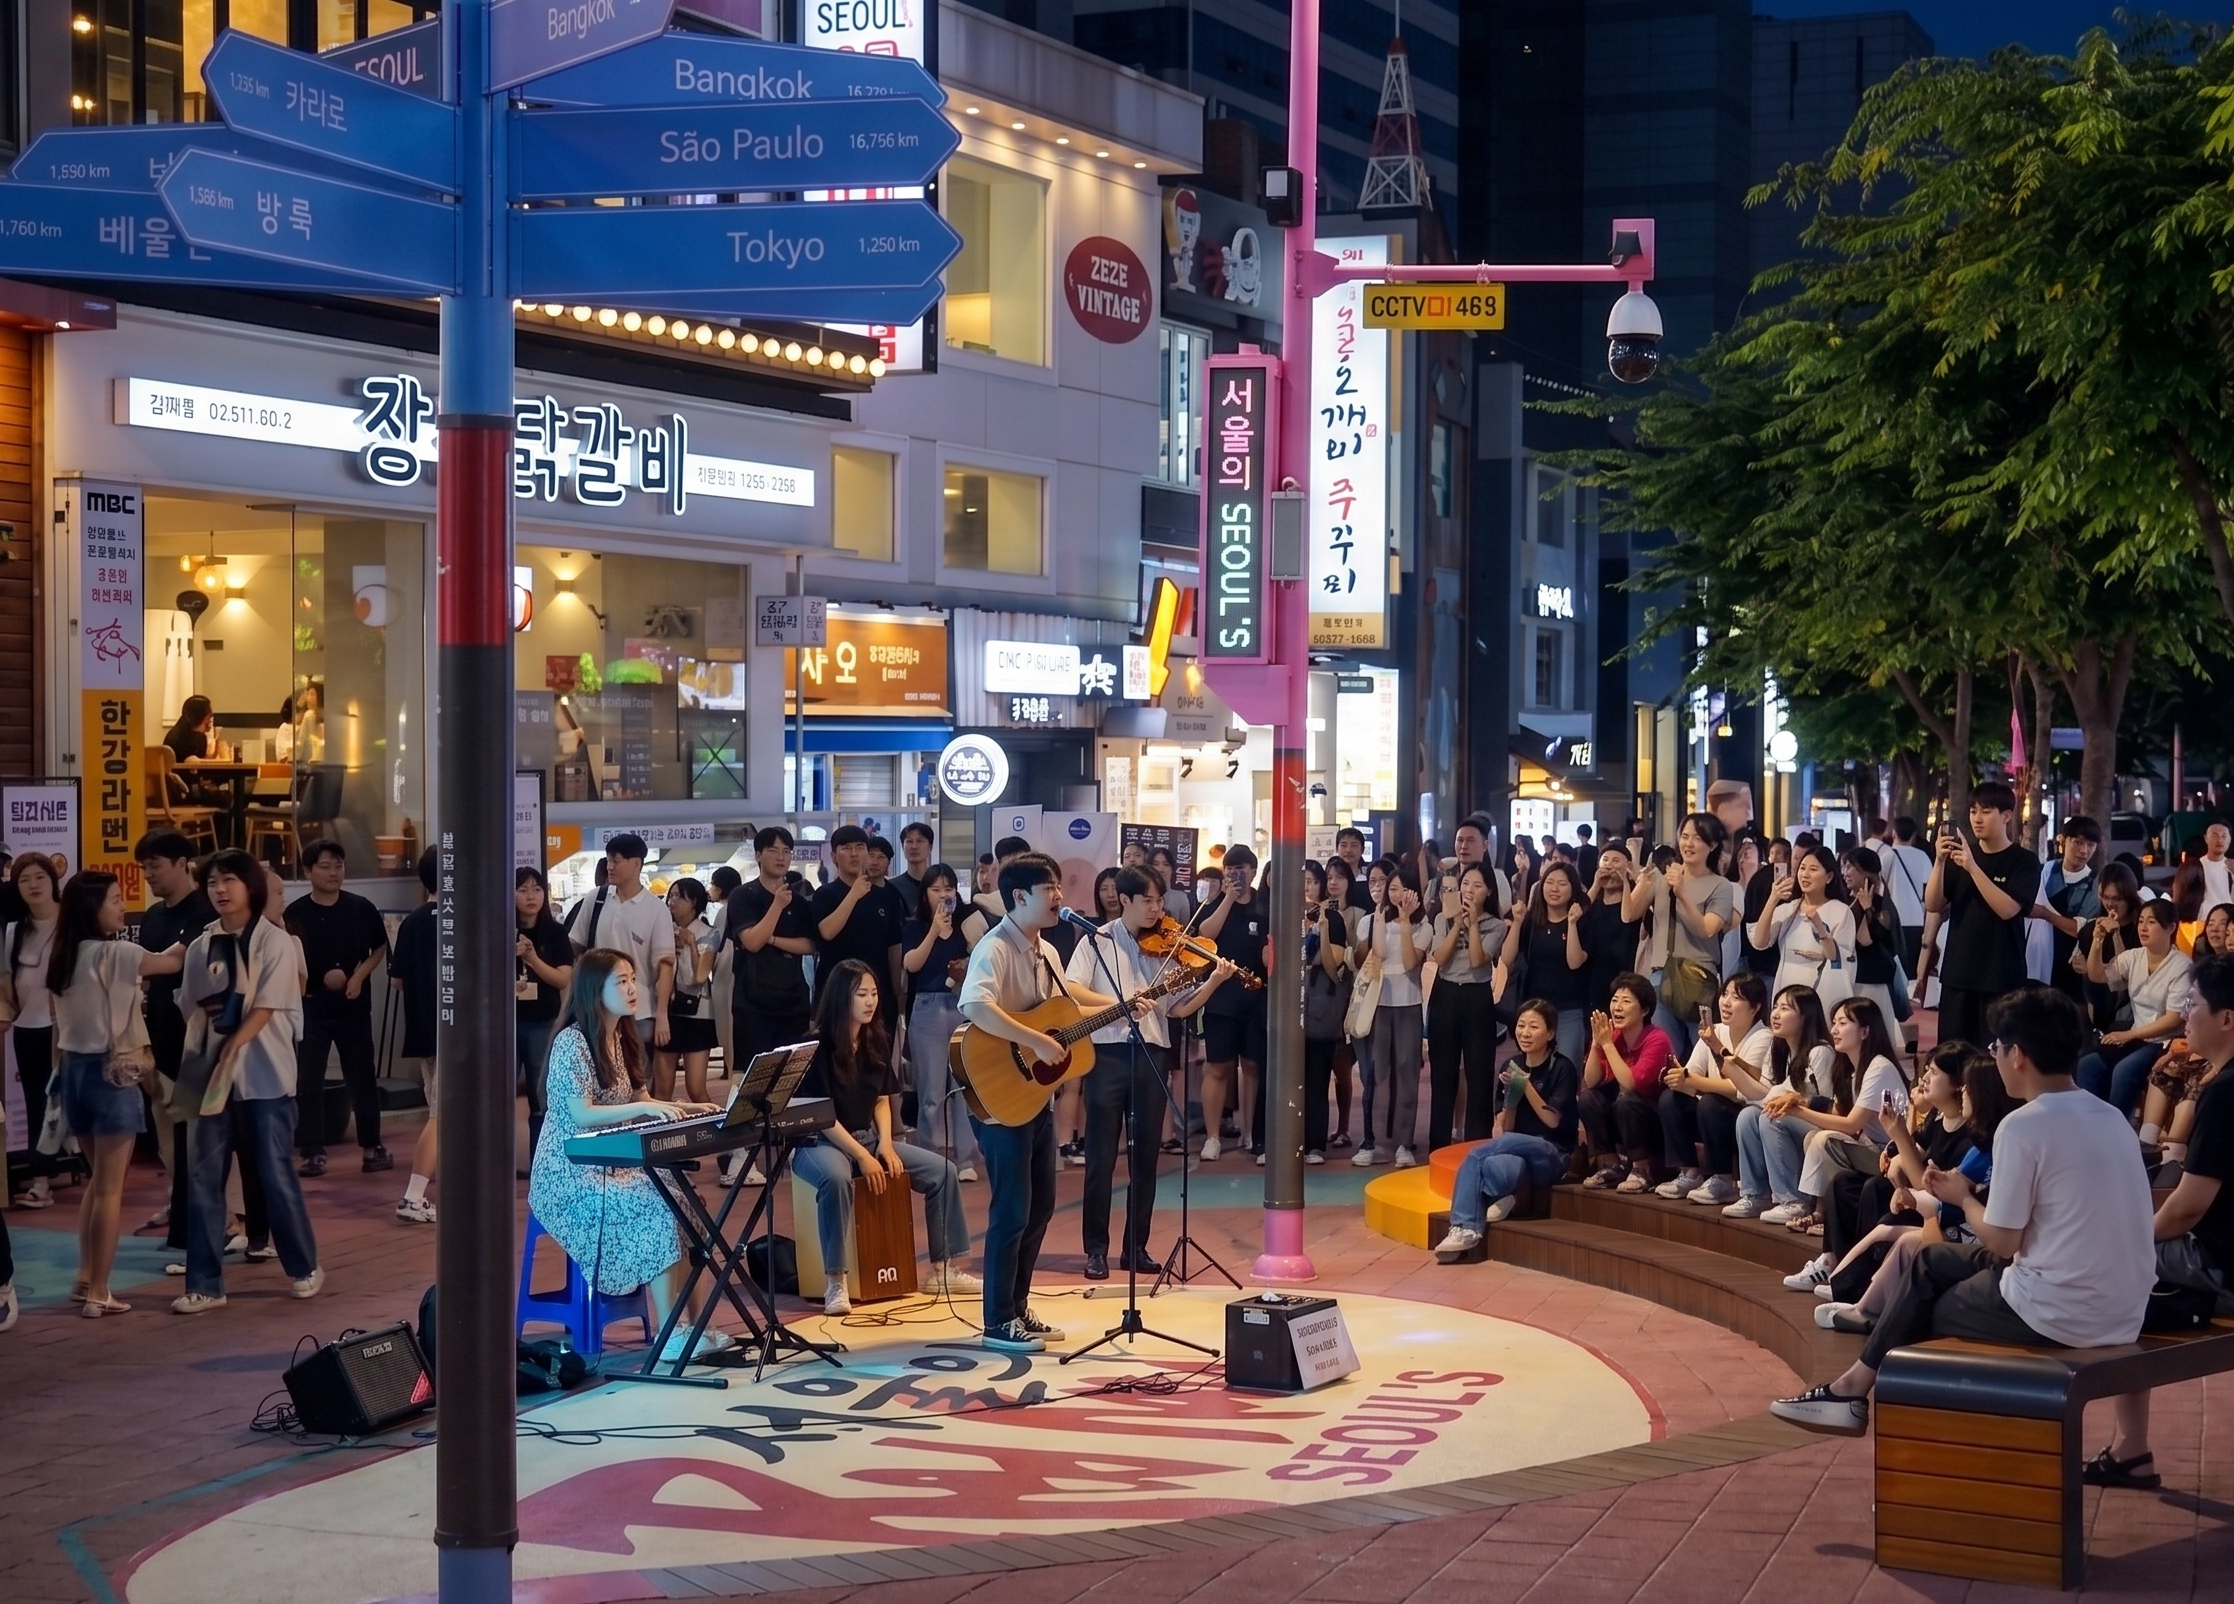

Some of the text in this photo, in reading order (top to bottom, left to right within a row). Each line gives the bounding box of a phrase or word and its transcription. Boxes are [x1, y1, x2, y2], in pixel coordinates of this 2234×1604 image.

[548, 0, 616, 41] Bangkok
[817, 0, 906, 34] SEOUL
[675, 58, 814, 99] Bangkok
[286, 81, 347, 132] 카라로
[661, 125, 919, 164] São Paulo 16,756 km
[89, 163, 110, 178] km
[218, 191, 234, 210] km
[40, 221, 62, 238] km
[727, 229, 920, 270] Tokyo 1,250 km
[1091, 255, 1129, 289] ZEZE
[1077, 284, 1141, 324] VINTAGE
[1218, 378, 1254, 492] 서울의
[86, 492, 136, 515] MBC
[1218, 502, 1252, 649] SEOUL'S
[1265, 1370, 1504, 1486] SEOUL'S
